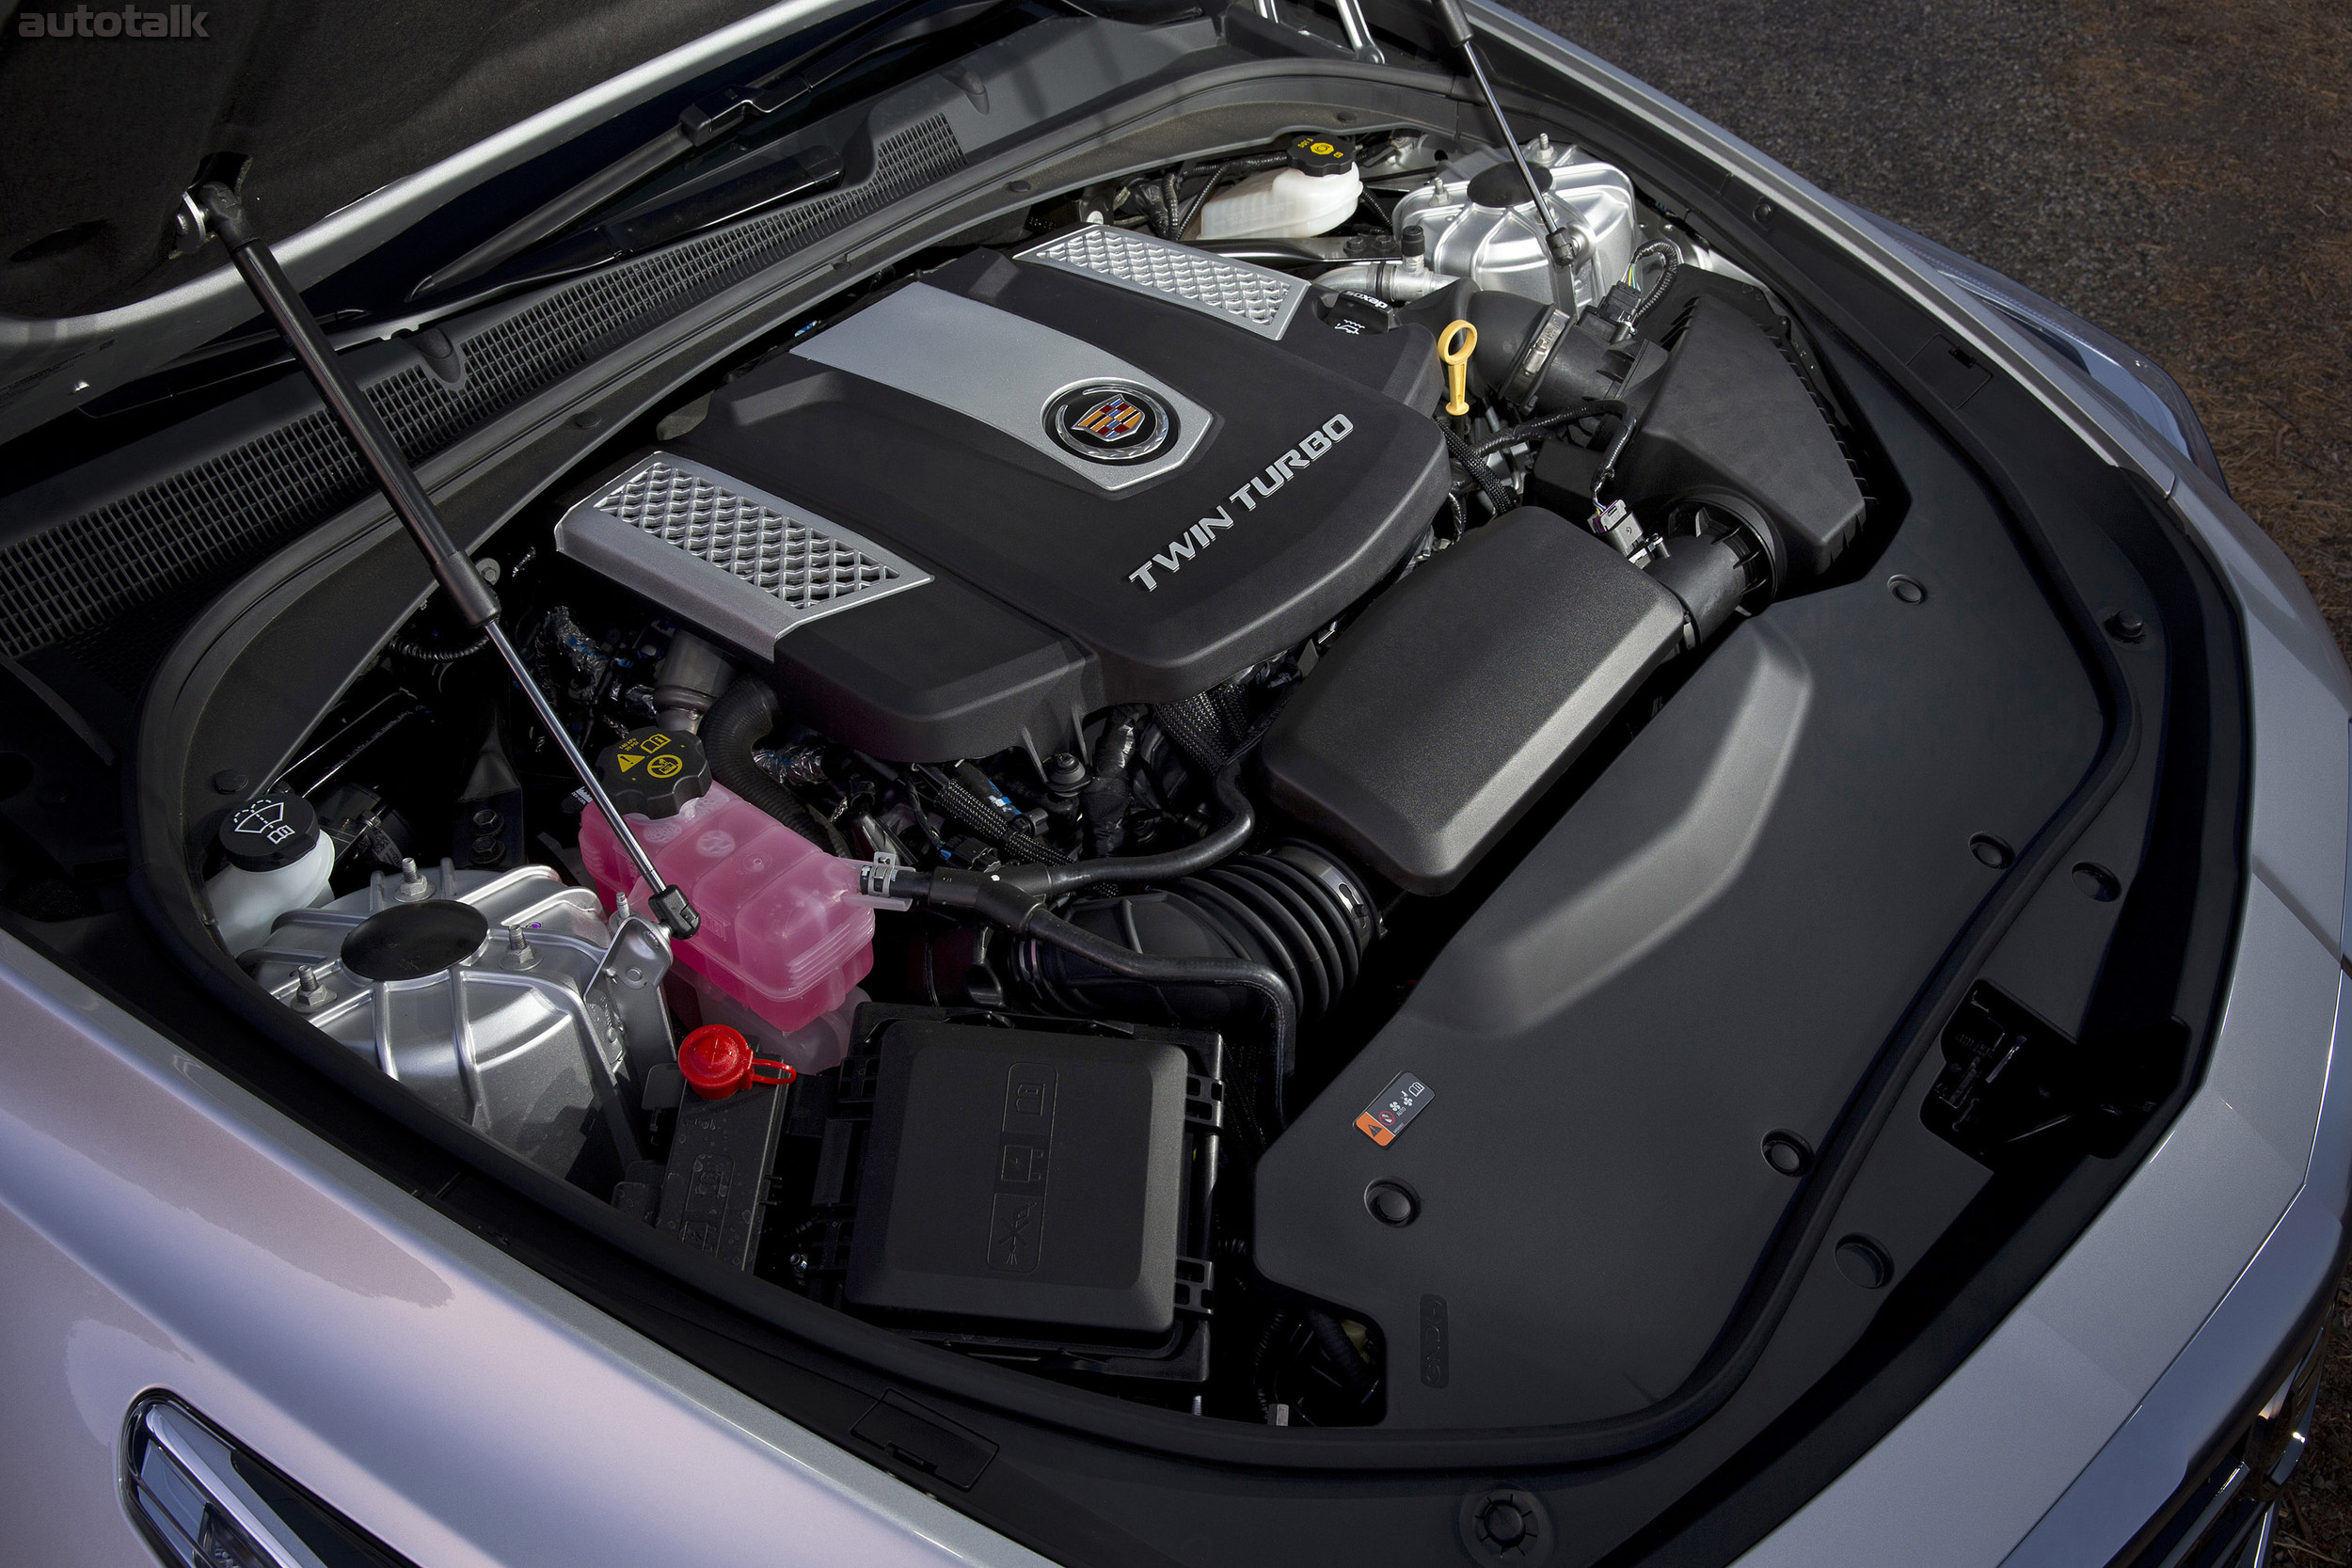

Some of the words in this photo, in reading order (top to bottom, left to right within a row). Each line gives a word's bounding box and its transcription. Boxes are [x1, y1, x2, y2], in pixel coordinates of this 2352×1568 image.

[1345, 291, 1389, 309] dexos
[1129, 505, 1234, 593] TWIN
[1229, 413, 1355, 512] TURBO
